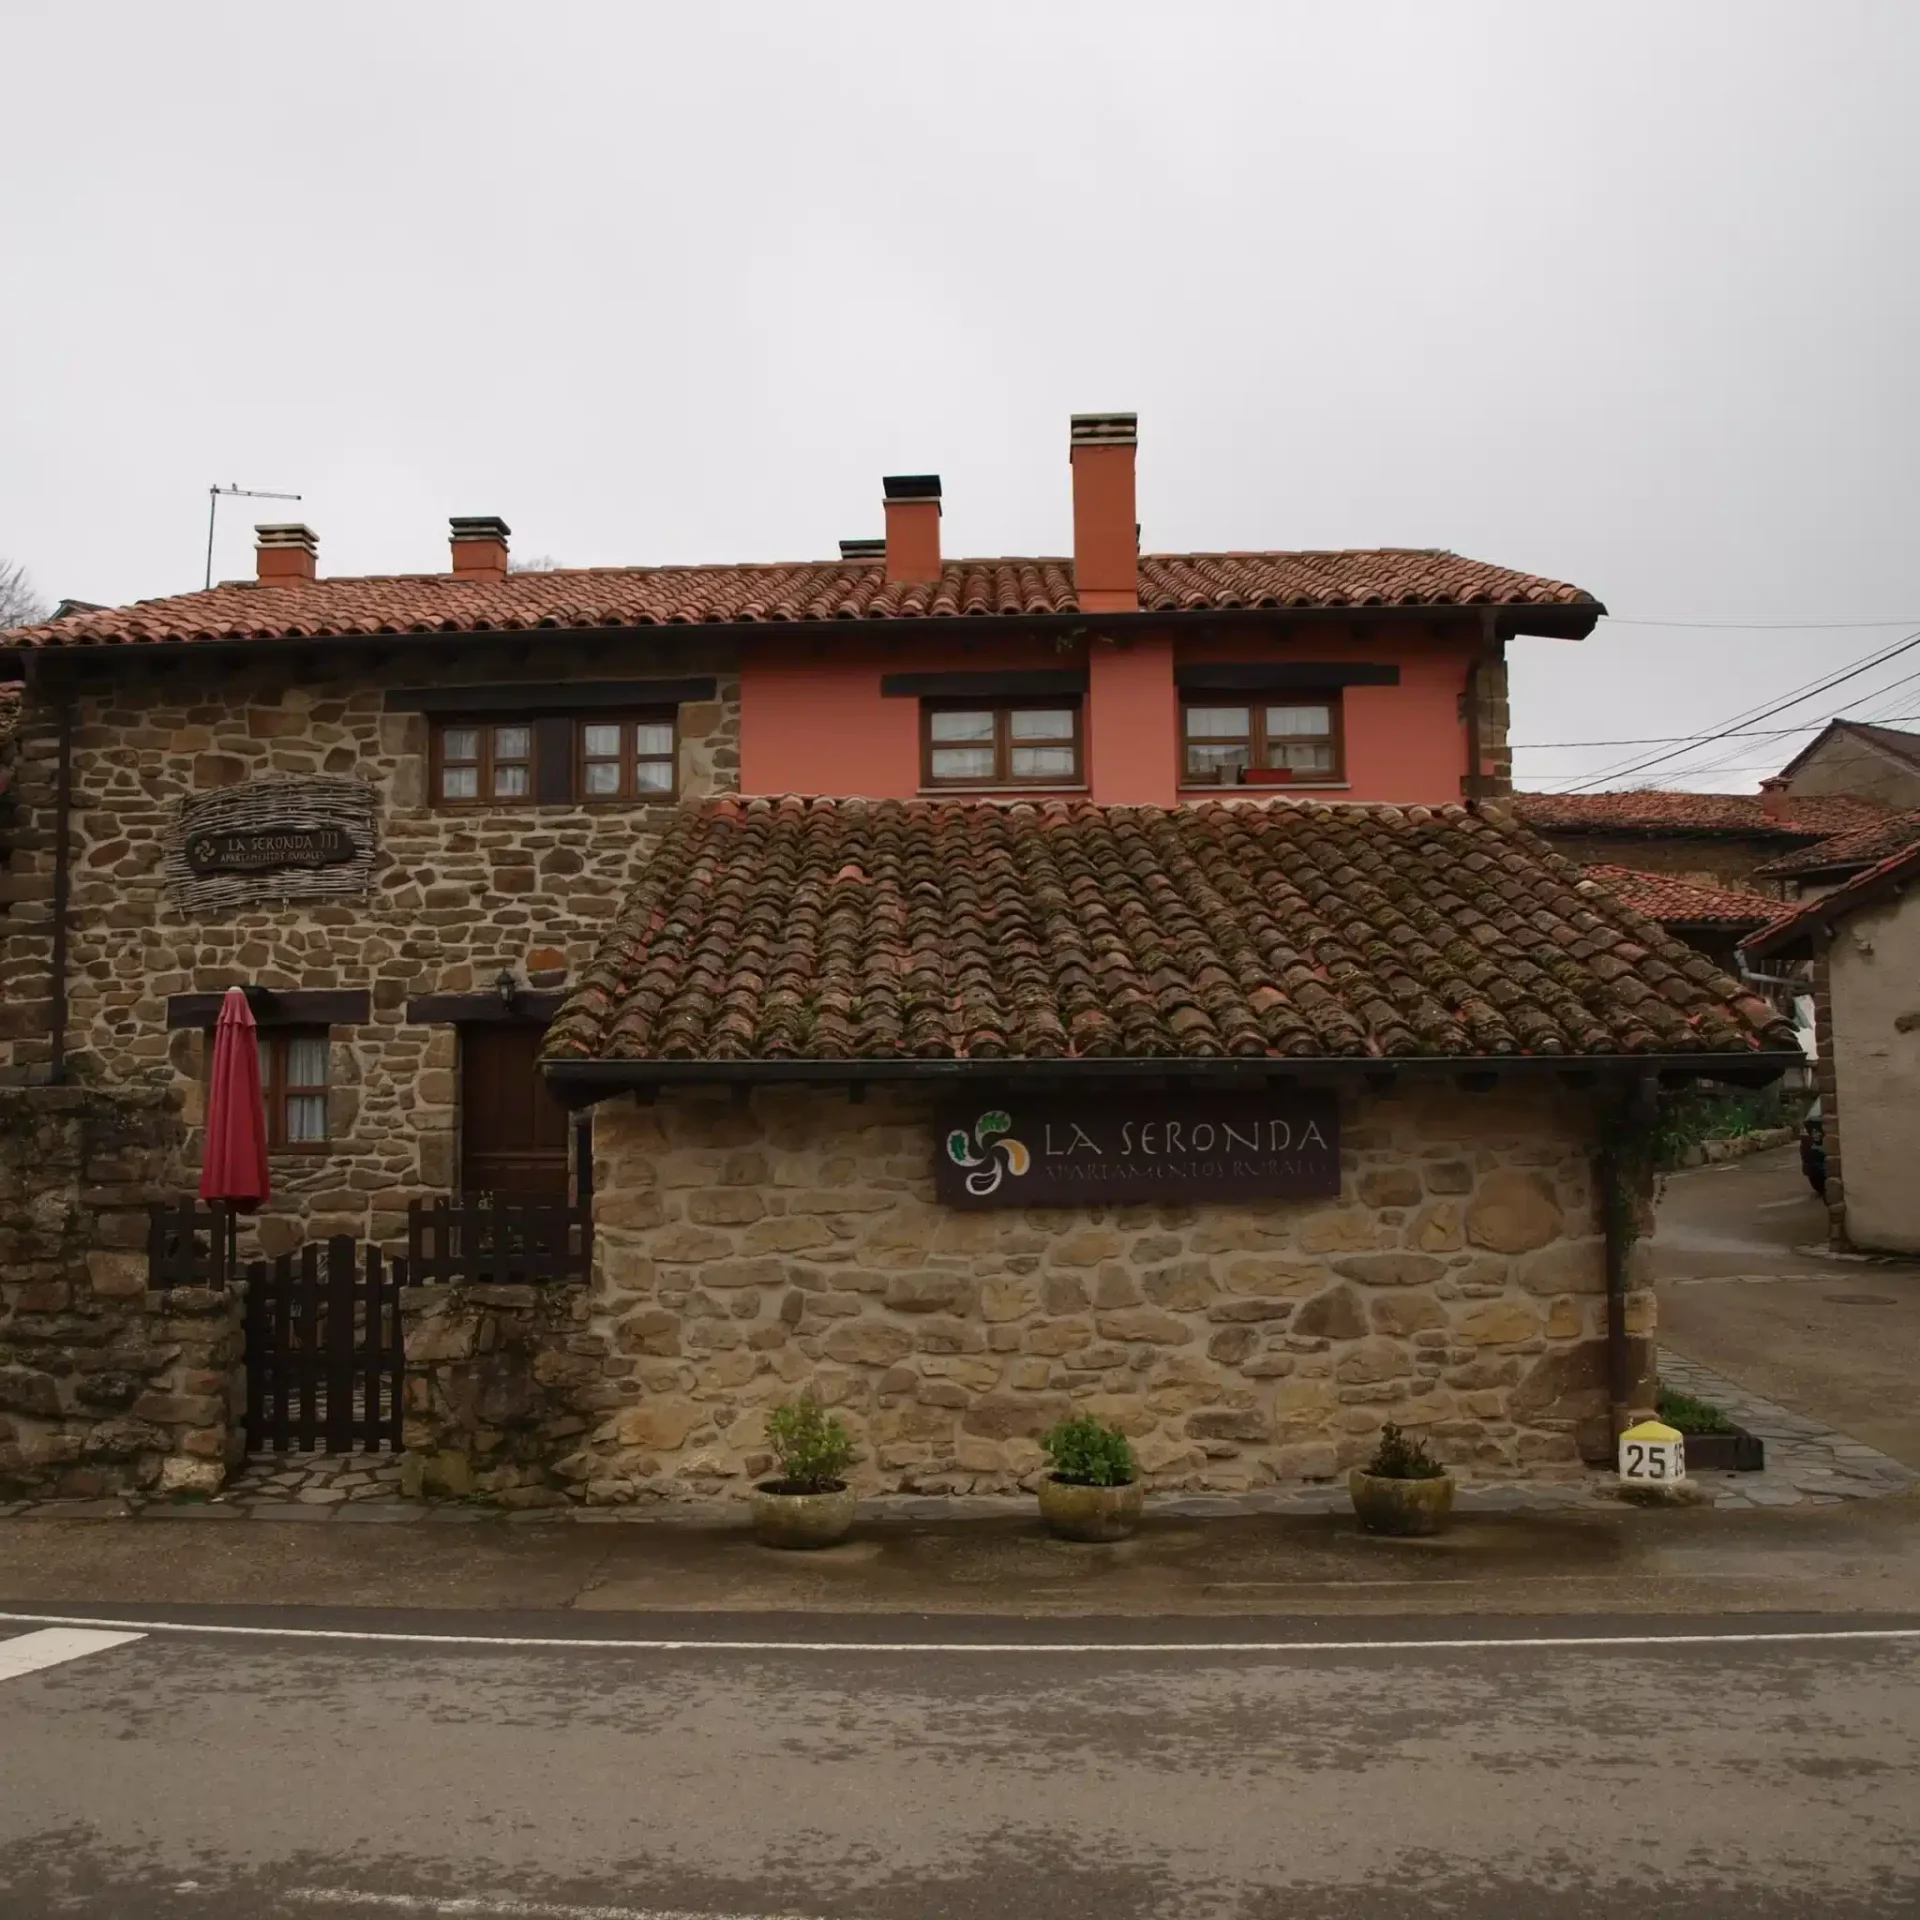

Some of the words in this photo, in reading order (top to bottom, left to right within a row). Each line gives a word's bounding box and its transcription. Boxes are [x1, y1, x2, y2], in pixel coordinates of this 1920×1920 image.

[228, 838, 246, 852] LA
[251, 835, 314, 850] SERONDA
[1045, 1122, 1103, 1155] LA
[1121, 1119, 1328, 1155] SERONDA
[1627, 1444, 1666, 1479] 25
